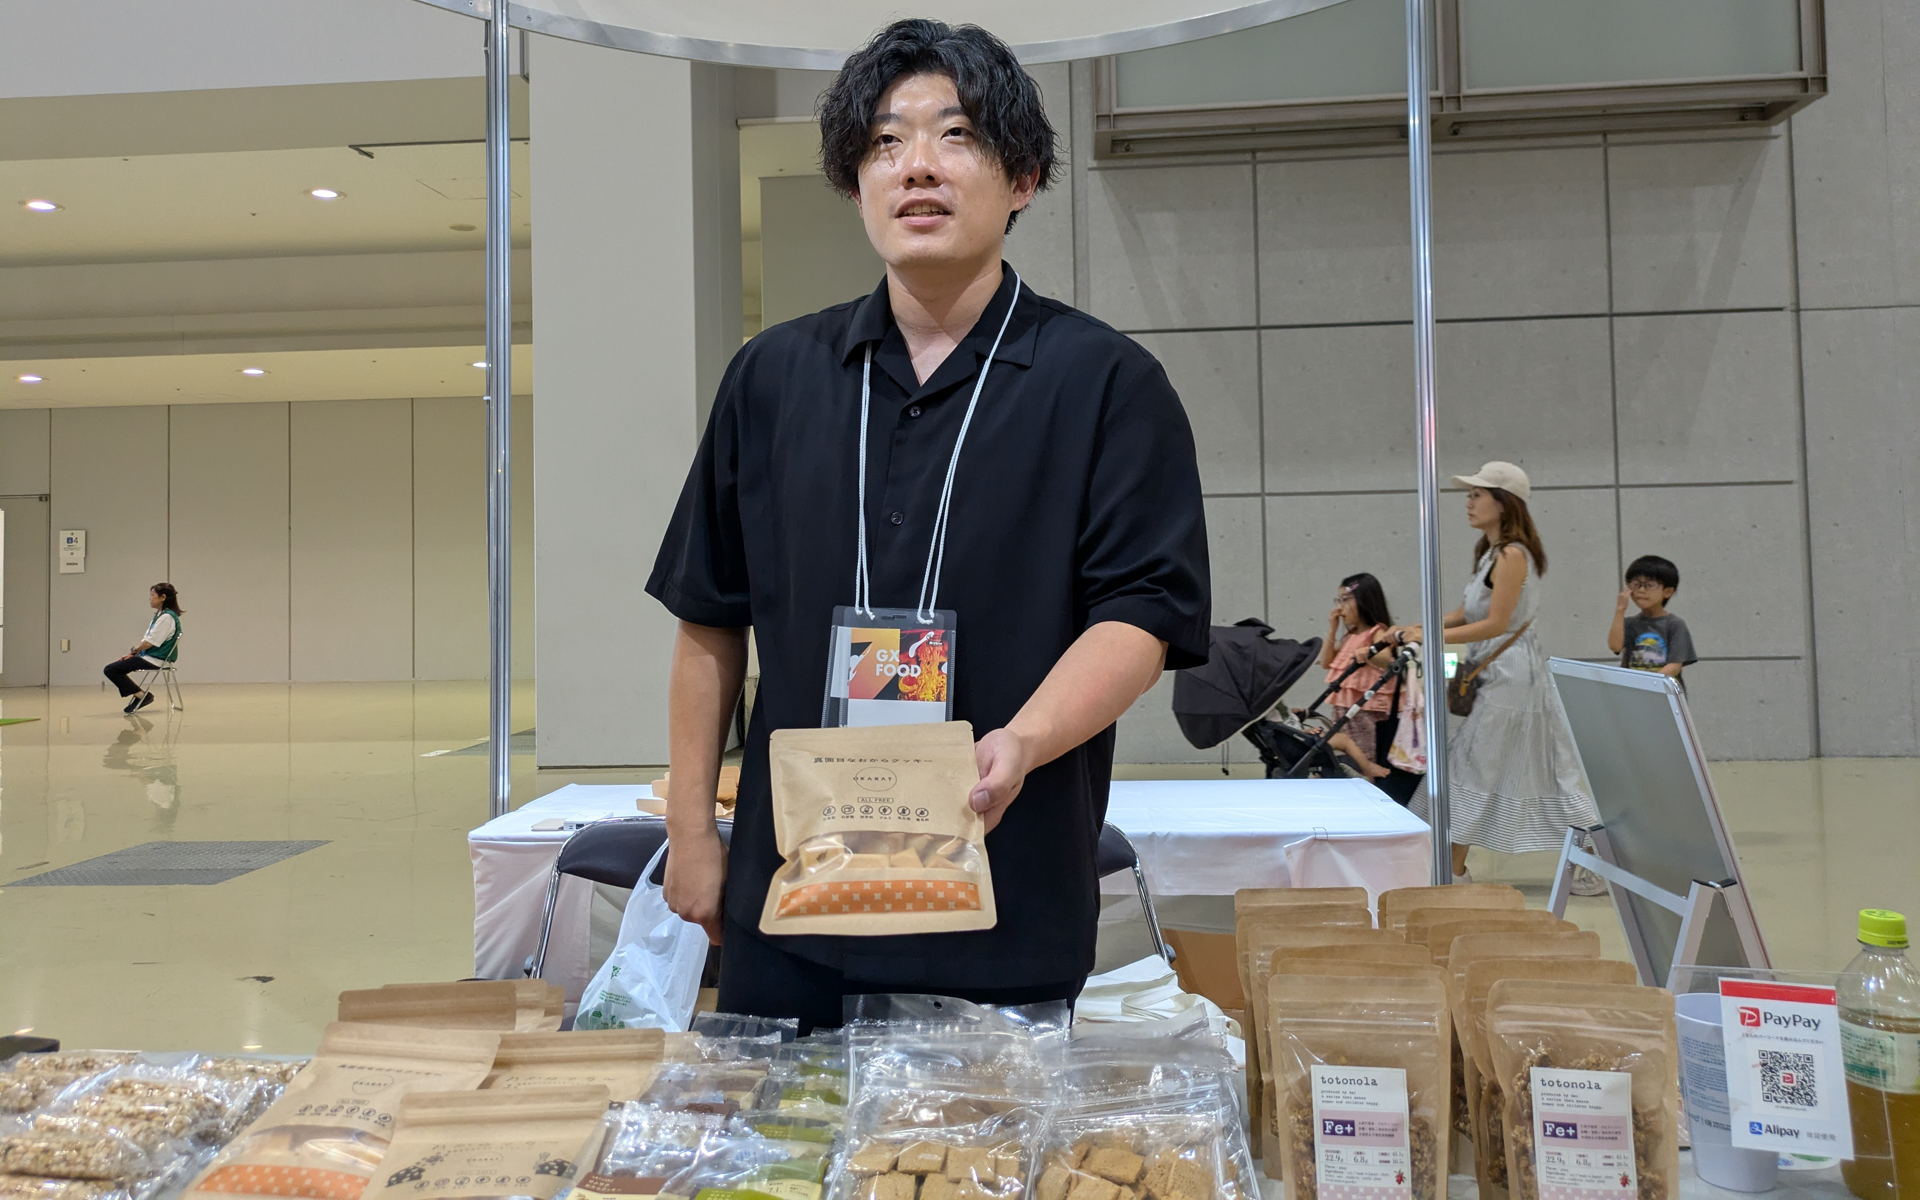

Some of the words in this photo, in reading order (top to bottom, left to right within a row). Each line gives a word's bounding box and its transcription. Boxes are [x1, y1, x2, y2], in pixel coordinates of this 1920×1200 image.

[876, 649, 900, 662] GX
[875, 663, 921, 677] FOOD
[1763, 1011, 1821, 1031] PayPay
[1321, 1075, 1378, 1086] totonola
[1540, 1078, 1602, 1090] totonola
[1324, 1120, 1353, 1134] Fe+
[1544, 1122, 1575, 1137] Fe+
[1764, 1123, 1800, 1138] Alipay
